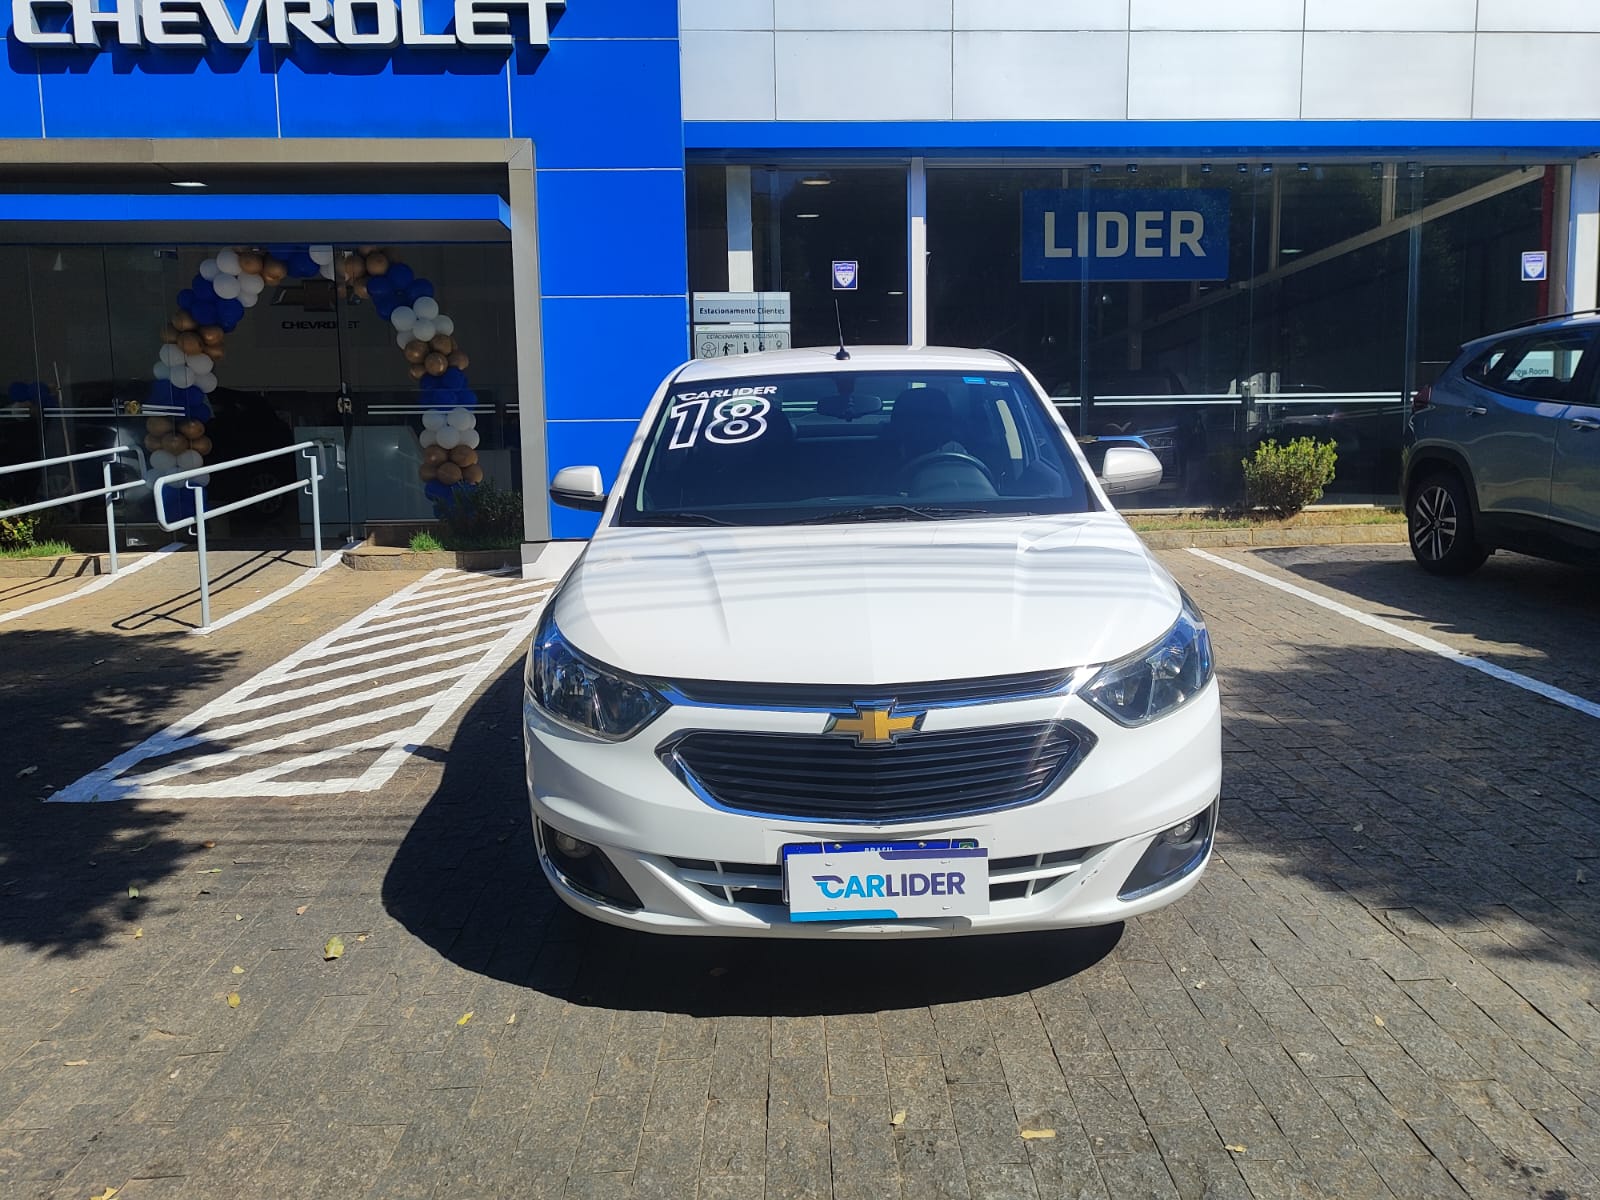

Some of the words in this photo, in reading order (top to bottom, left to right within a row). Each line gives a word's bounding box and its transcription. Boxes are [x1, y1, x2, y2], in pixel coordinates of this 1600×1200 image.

[11, 0, 566, 48] CHEVROLET
[1044, 210, 1207, 258] LIDER
[699, 307, 755, 315] Estacionamento
[758, 306, 785, 315] Clientes
[281, 320, 360, 329] CHEVROET
[677, 386, 778, 401] CARLIDER
[668, 395, 771, 450] 18
[811, 872, 966, 899] CARLIDER
